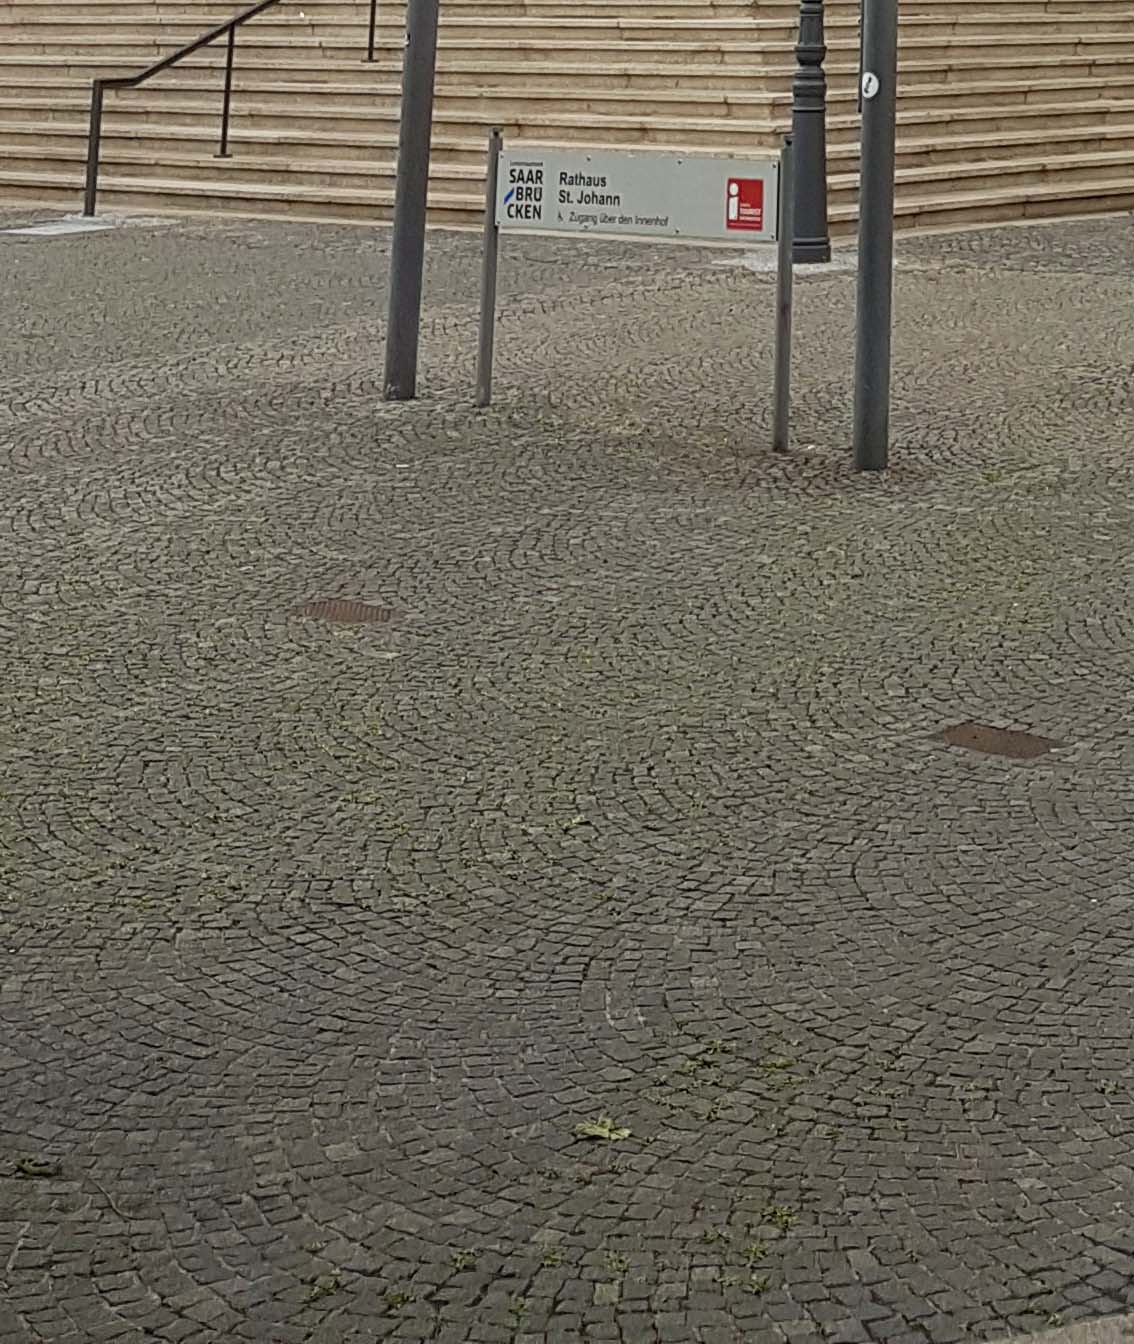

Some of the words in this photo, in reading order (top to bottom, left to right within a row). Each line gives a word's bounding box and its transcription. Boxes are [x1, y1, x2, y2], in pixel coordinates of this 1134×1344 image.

[509, 169, 543, 184] SAAR
[559, 171, 607, 187] Rathaus
[516, 186, 543, 201] BRÜ
[558, 190, 573, 204] St.
[577, 191, 621, 206] Johann
[507, 204, 542, 220] CKEN
[569, 211, 598, 225] Zugang
[599, 213, 617, 224] über
[618, 214, 633, 224] den
[635, 215, 669, 227] Innenhof
